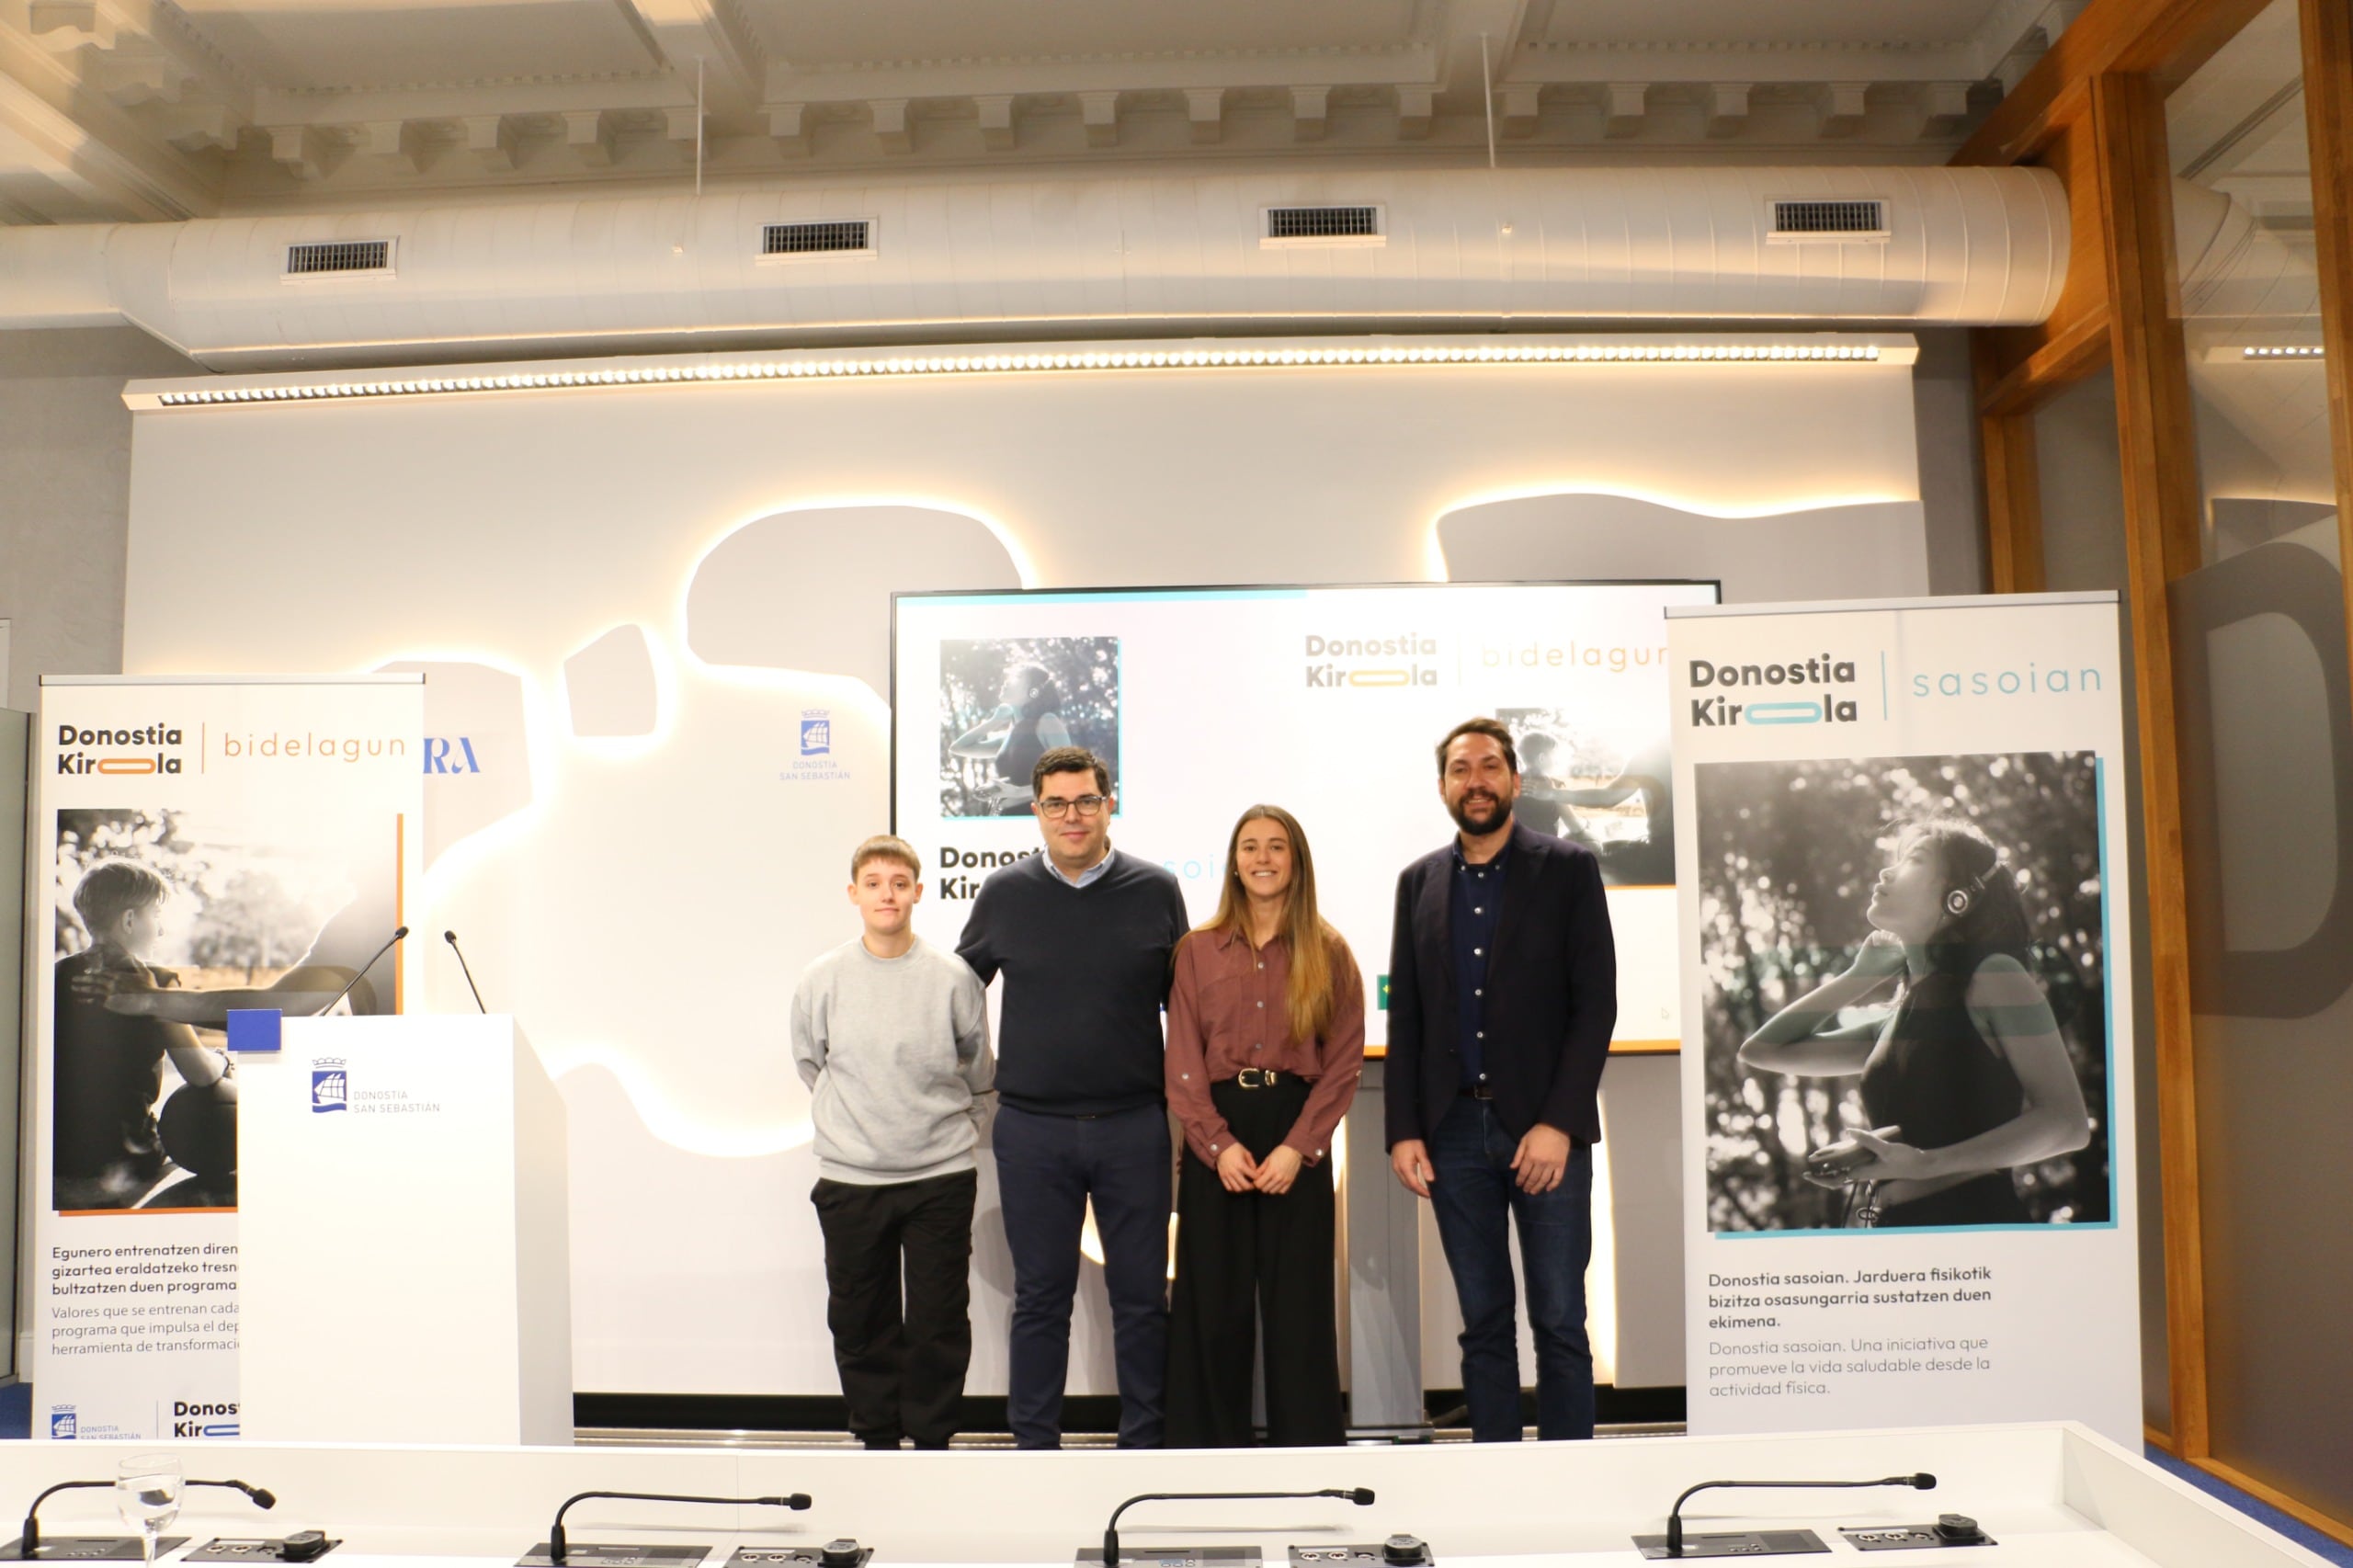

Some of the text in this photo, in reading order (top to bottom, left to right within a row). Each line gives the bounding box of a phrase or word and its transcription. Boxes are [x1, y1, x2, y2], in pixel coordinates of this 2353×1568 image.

[1305, 632, 1437, 656] Donostia
[1689, 653, 1856, 687] Donostia
[1913, 662, 2101, 697] sasoian
[59, 722, 182, 746] Donostia
[225, 733, 405, 763] bidelagun
[793, 760, 837, 769] DONOSTIA
[779, 772, 798, 780] SAN
[354, 1091, 408, 1100] DONOSTIA
[354, 1102, 440, 1114] SAN SEBASTIÁN
[52, 1243, 238, 1261] Egunero entrenatzen diren
[52, 1262, 239, 1279] gizartea eraldatzeko tresn
[1709, 1267, 1992, 1288] Donostia sasoian. Jarduera fisikotik
[52, 1281, 237, 1295] bultzatzen duen programa
[1709, 1289, 1992, 1309] bizitza osasungarria sustatzen duen
[52, 1307, 99, 1319] Valores
[103, 1308, 129, 1320] que
[131, 1307, 145, 1316] se
[149, 1305, 208, 1315] entrenan
[52, 1325, 118, 1339] programa
[120, 1324, 145, 1337] que
[149, 1321, 199, 1336] impulsa
[203, 1320, 214, 1332] el
[1709, 1315, 1781, 1329] ekimena.
[52, 1342, 133, 1355] herramienta
[137, 1340, 153, 1353] de
[1709, 1336, 1989, 1356] Donostia sasoian. Una iniciativa que
[1710, 1356, 1990, 1379] promueve la vida saludable desde la
[1710, 1380, 1831, 1397] actividad física.
[174, 1402, 240, 1416] Donos
[80, 1425, 119, 1434] DONOSTIA
